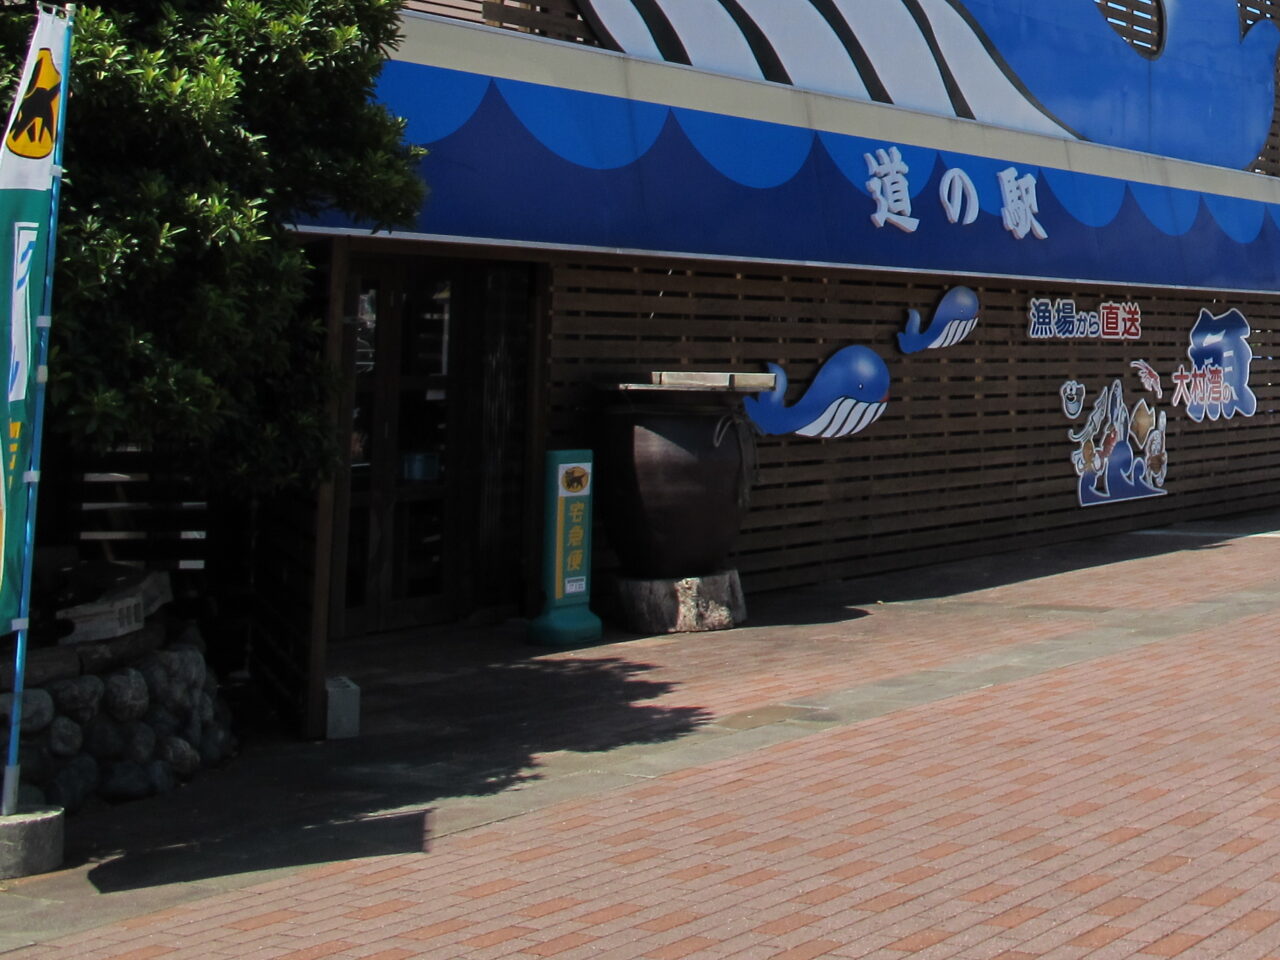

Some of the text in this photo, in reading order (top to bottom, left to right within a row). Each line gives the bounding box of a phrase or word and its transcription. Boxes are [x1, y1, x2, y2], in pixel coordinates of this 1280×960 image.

[863, 146, 1048, 240] 道の駅
[1030, 297, 1141, 339] 漁場から直送
[1172, 364, 1232, 407] 大村湾の
[567, 501, 585, 572] 宅急便
